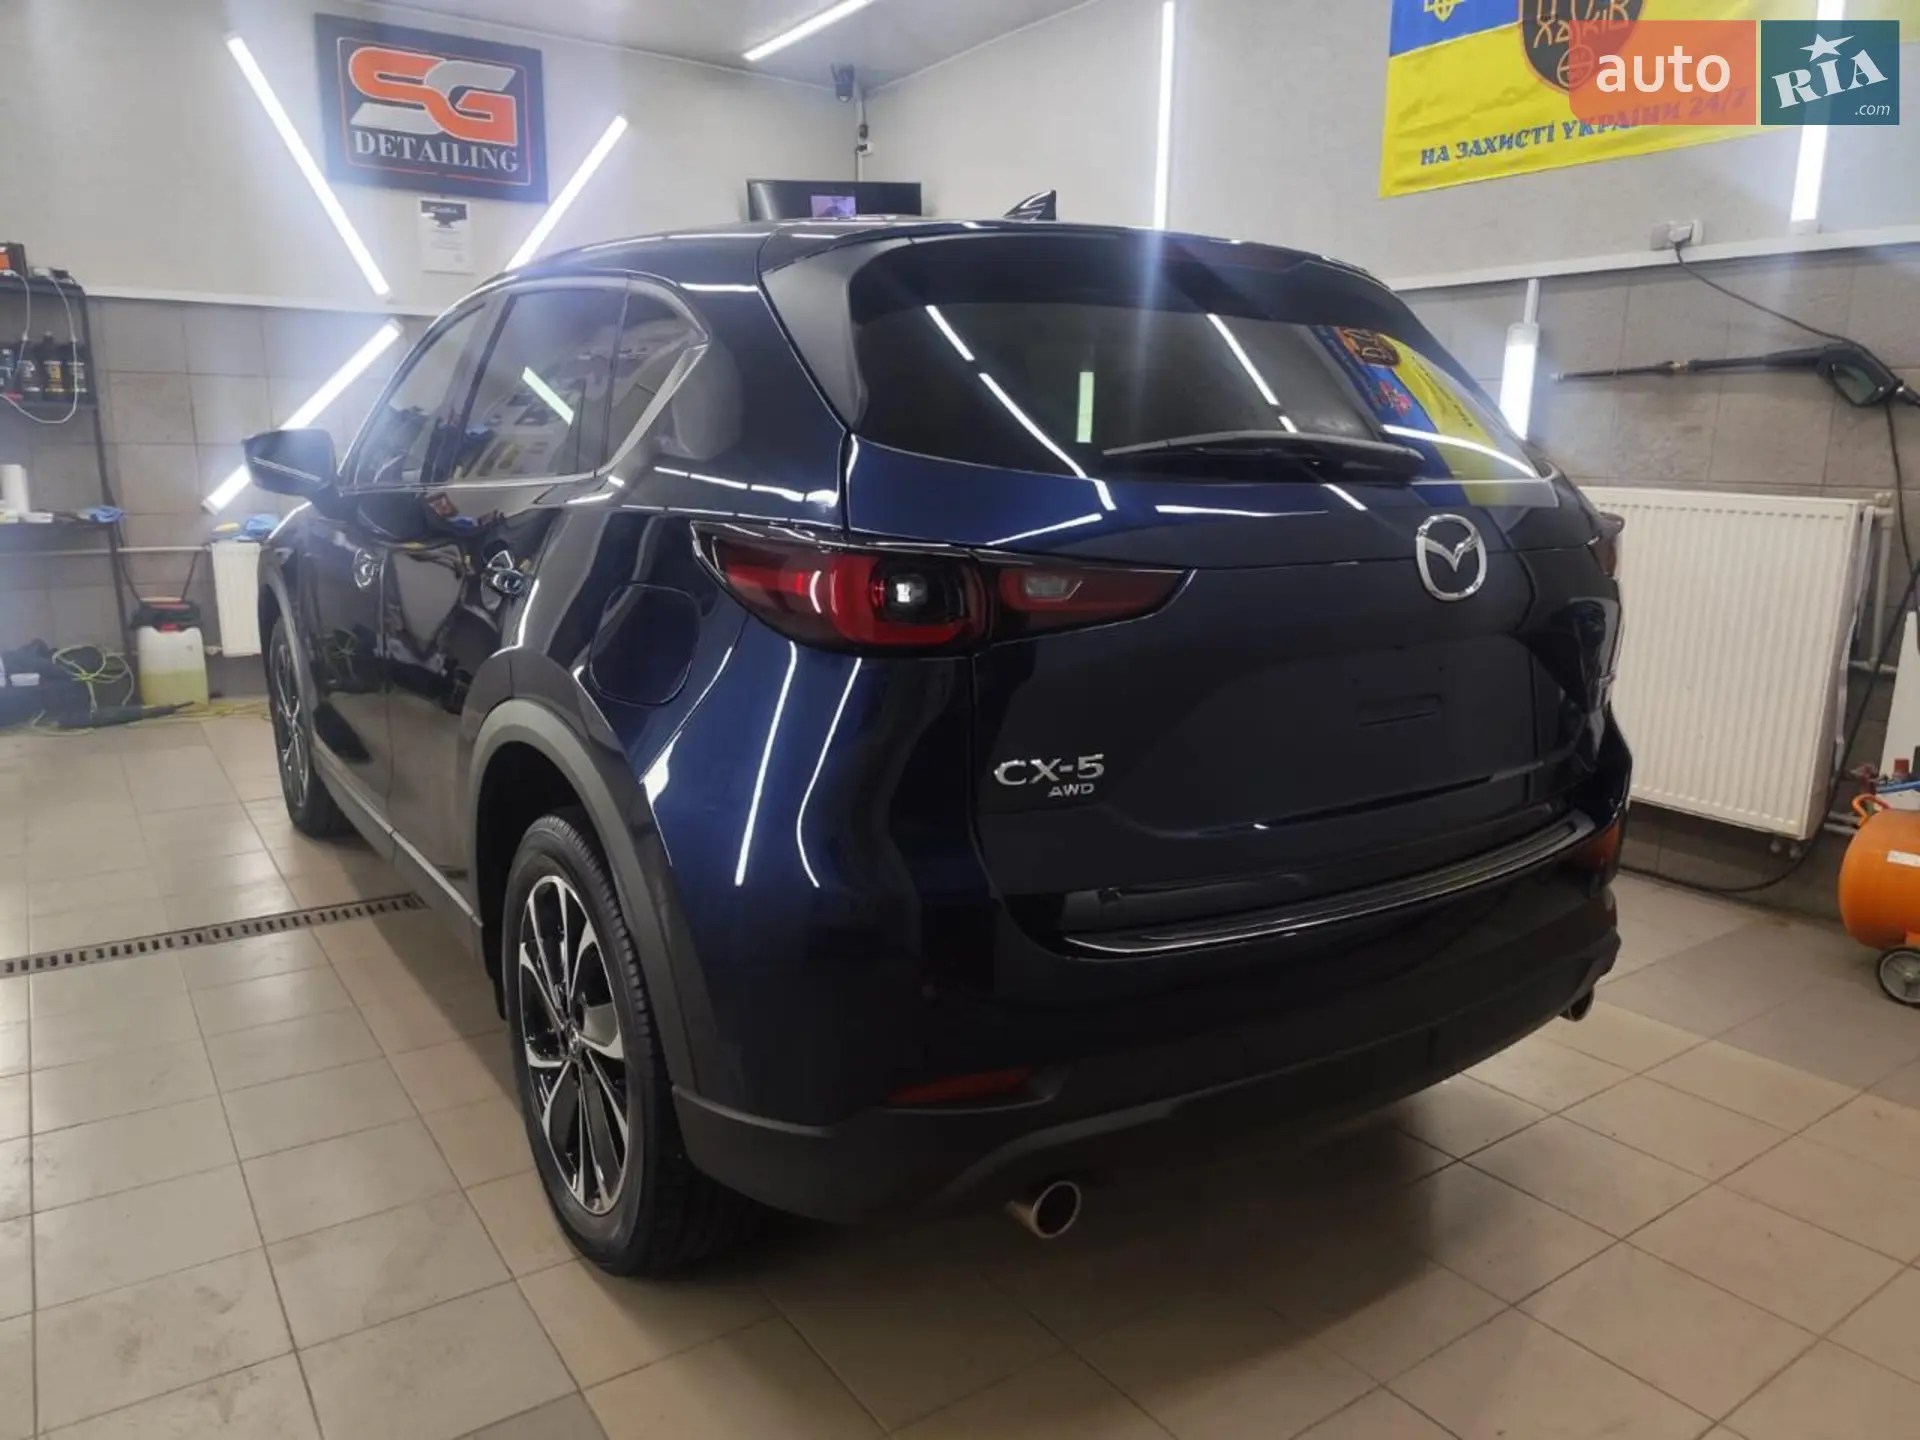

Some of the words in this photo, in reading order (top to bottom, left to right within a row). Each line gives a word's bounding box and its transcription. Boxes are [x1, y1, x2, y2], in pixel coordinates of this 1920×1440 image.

[349, 46, 517, 146] SG
[353, 130, 518, 173] DETAILING
[1420, 145, 1450, 166] НА
[1454, 120, 1555, 160] ЗАХИСТІ
[993, 753, 1105, 786] CX-5
[1048, 783, 1095, 798] AWD
